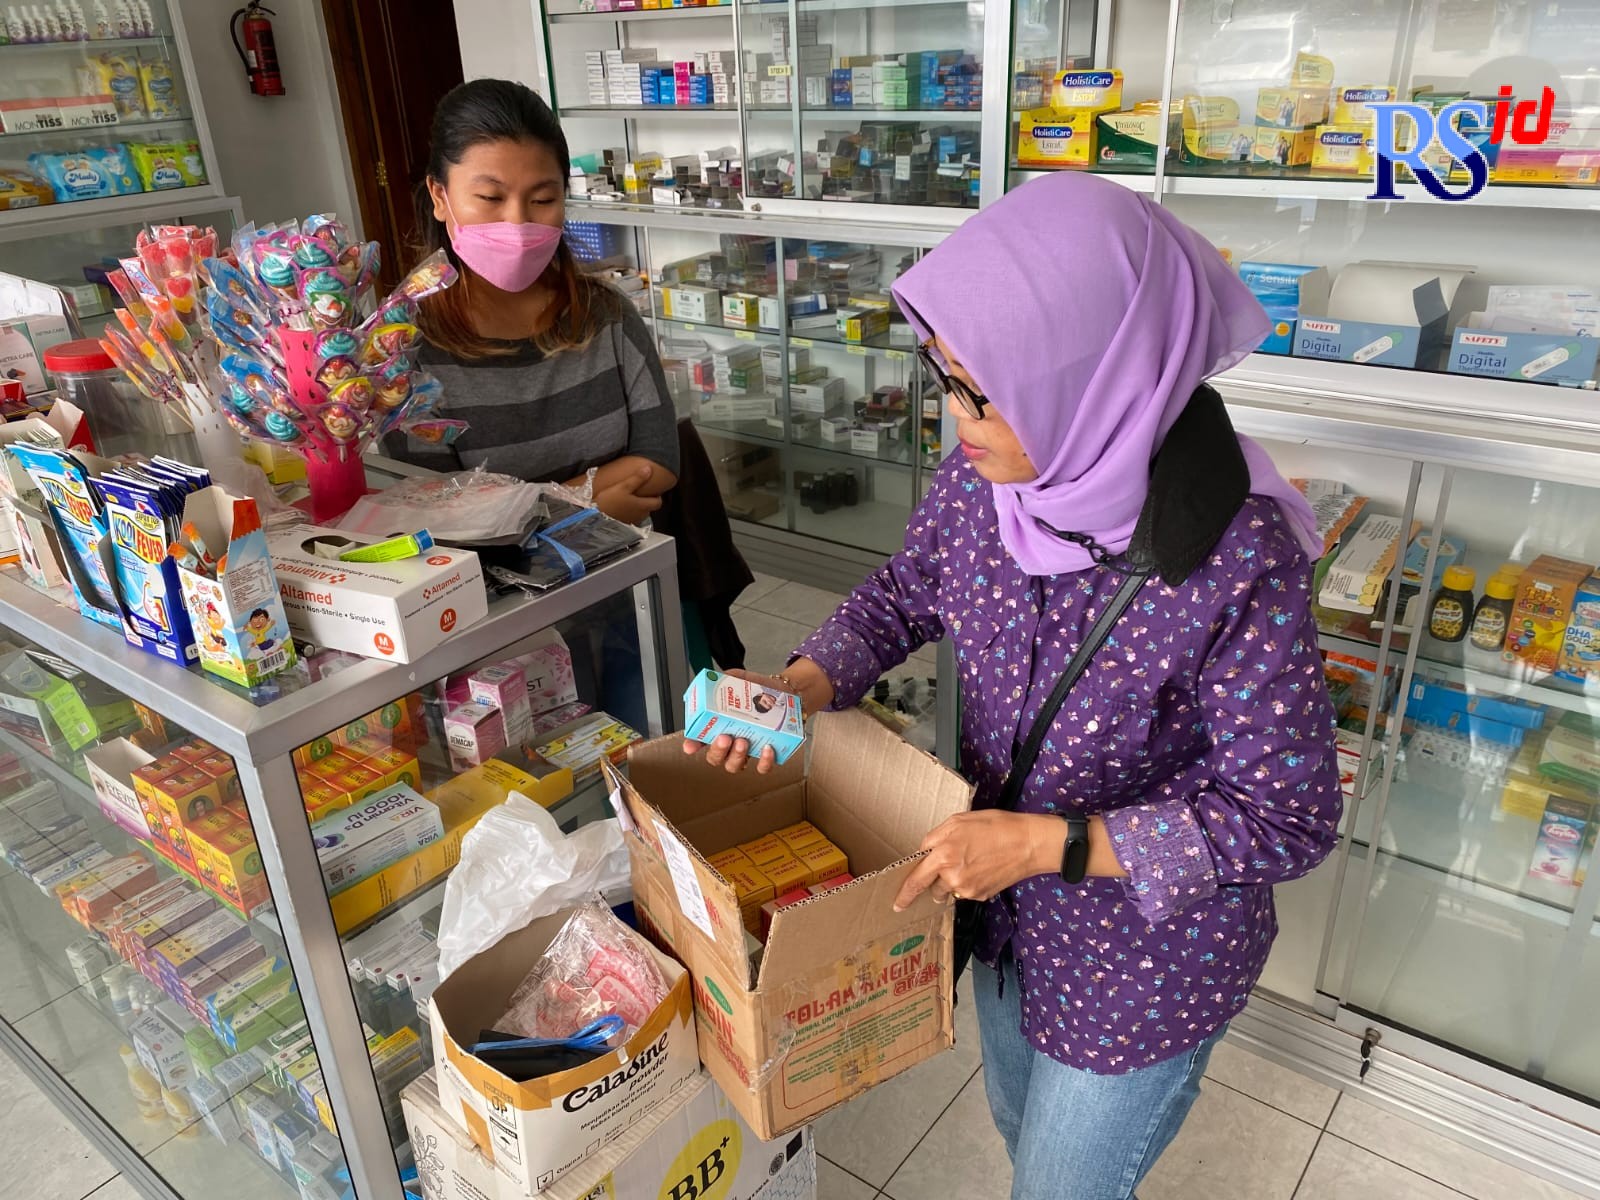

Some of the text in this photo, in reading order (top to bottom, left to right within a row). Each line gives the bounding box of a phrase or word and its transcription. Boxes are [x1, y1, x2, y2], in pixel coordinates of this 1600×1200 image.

[1064, 74, 1111, 87] HolistiCare
[1345, 91, 1387, 101] HolistiCare
[15, 118, 62, 131] MONTISS
[71, 113, 117, 126] MONTISS
[1034, 128, 1071, 138] HolistiCare
[1322, 134, 1363, 144] HolistiCare
[1302, 339, 1341, 354] Digital
[1458, 353, 1507, 369] Digital
[135, 529, 164, 563] FEVER
[431, 572, 461, 594] Altamed
[280, 583, 333, 605] Altamed
[349, 612, 371, 624] Single
[372, 616, 386, 626] Use
[443, 611, 453, 624] M
[1566, 634, 1590, 645] GOLD
[1567, 626, 1592, 639] DHA
[378, 636, 389, 647] M
[526, 677, 543, 692] ST
[346, 793, 406, 823] 1000 IU
[365, 797, 415, 823] Vitamin
[417, 831, 439, 847] VIRA
[893, 962, 941, 997] anak
[784, 985, 857, 1027] TOLAK
[859, 952, 924, 995] ANGIN
[821, 1010, 844, 1025] UNTUK
[866, 988, 888, 1003] ANGIN
[562, 1031, 670, 1113] Caladine
[629, 1051, 669, 1091] powder
[580, 1102, 620, 1131] Menjadikan
[653, 1069, 665, 1080] dan
[611, 1102, 630, 1118] biang
[556, 1153, 583, 1175] Original
